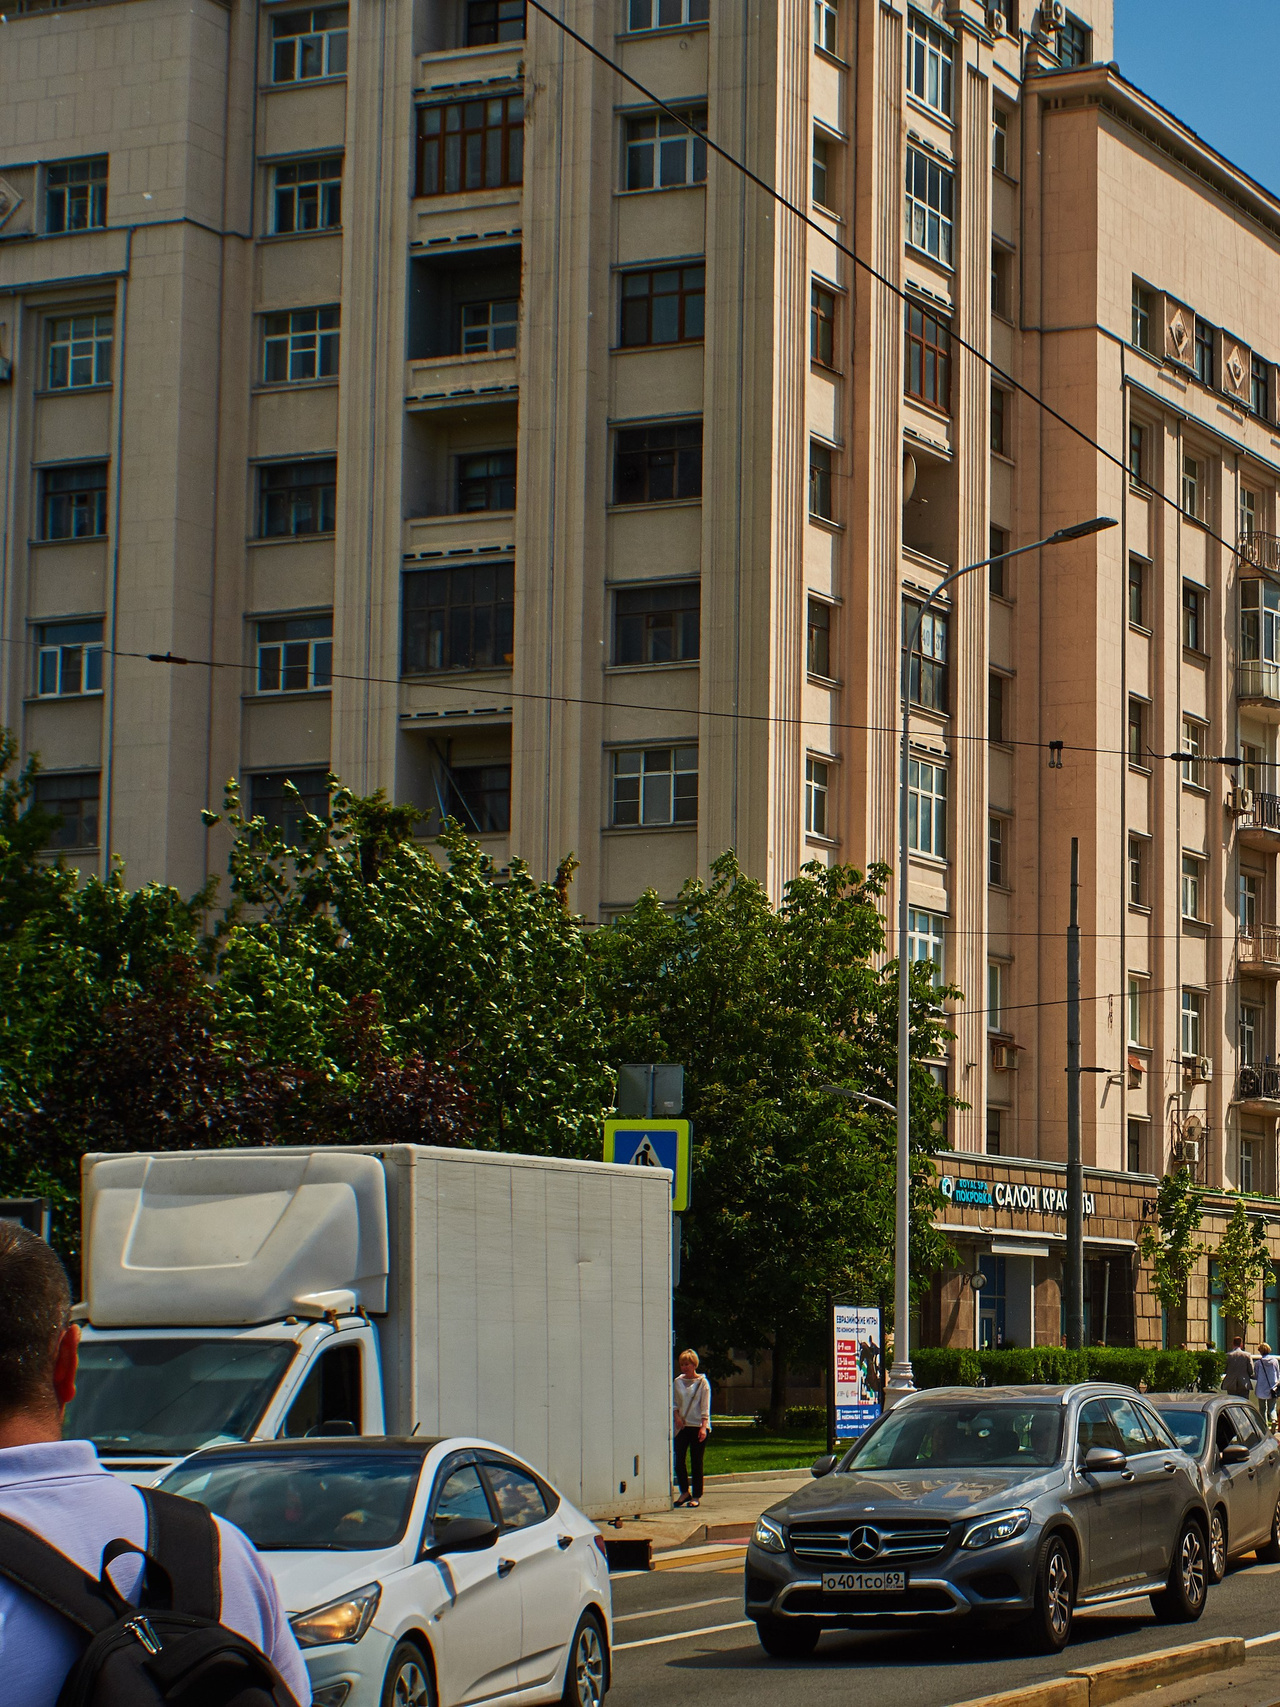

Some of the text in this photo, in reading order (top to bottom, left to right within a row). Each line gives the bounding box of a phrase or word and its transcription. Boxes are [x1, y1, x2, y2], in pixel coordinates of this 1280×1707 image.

[959, 1179, 988, 1191] ROYAL SPA
[955, 1190, 993, 1205] ПОКРОВКА
[995, 1183, 1095, 1214] САЛОН КРАТЫ
[827, 1573, 900, 1590] О401СО 69
